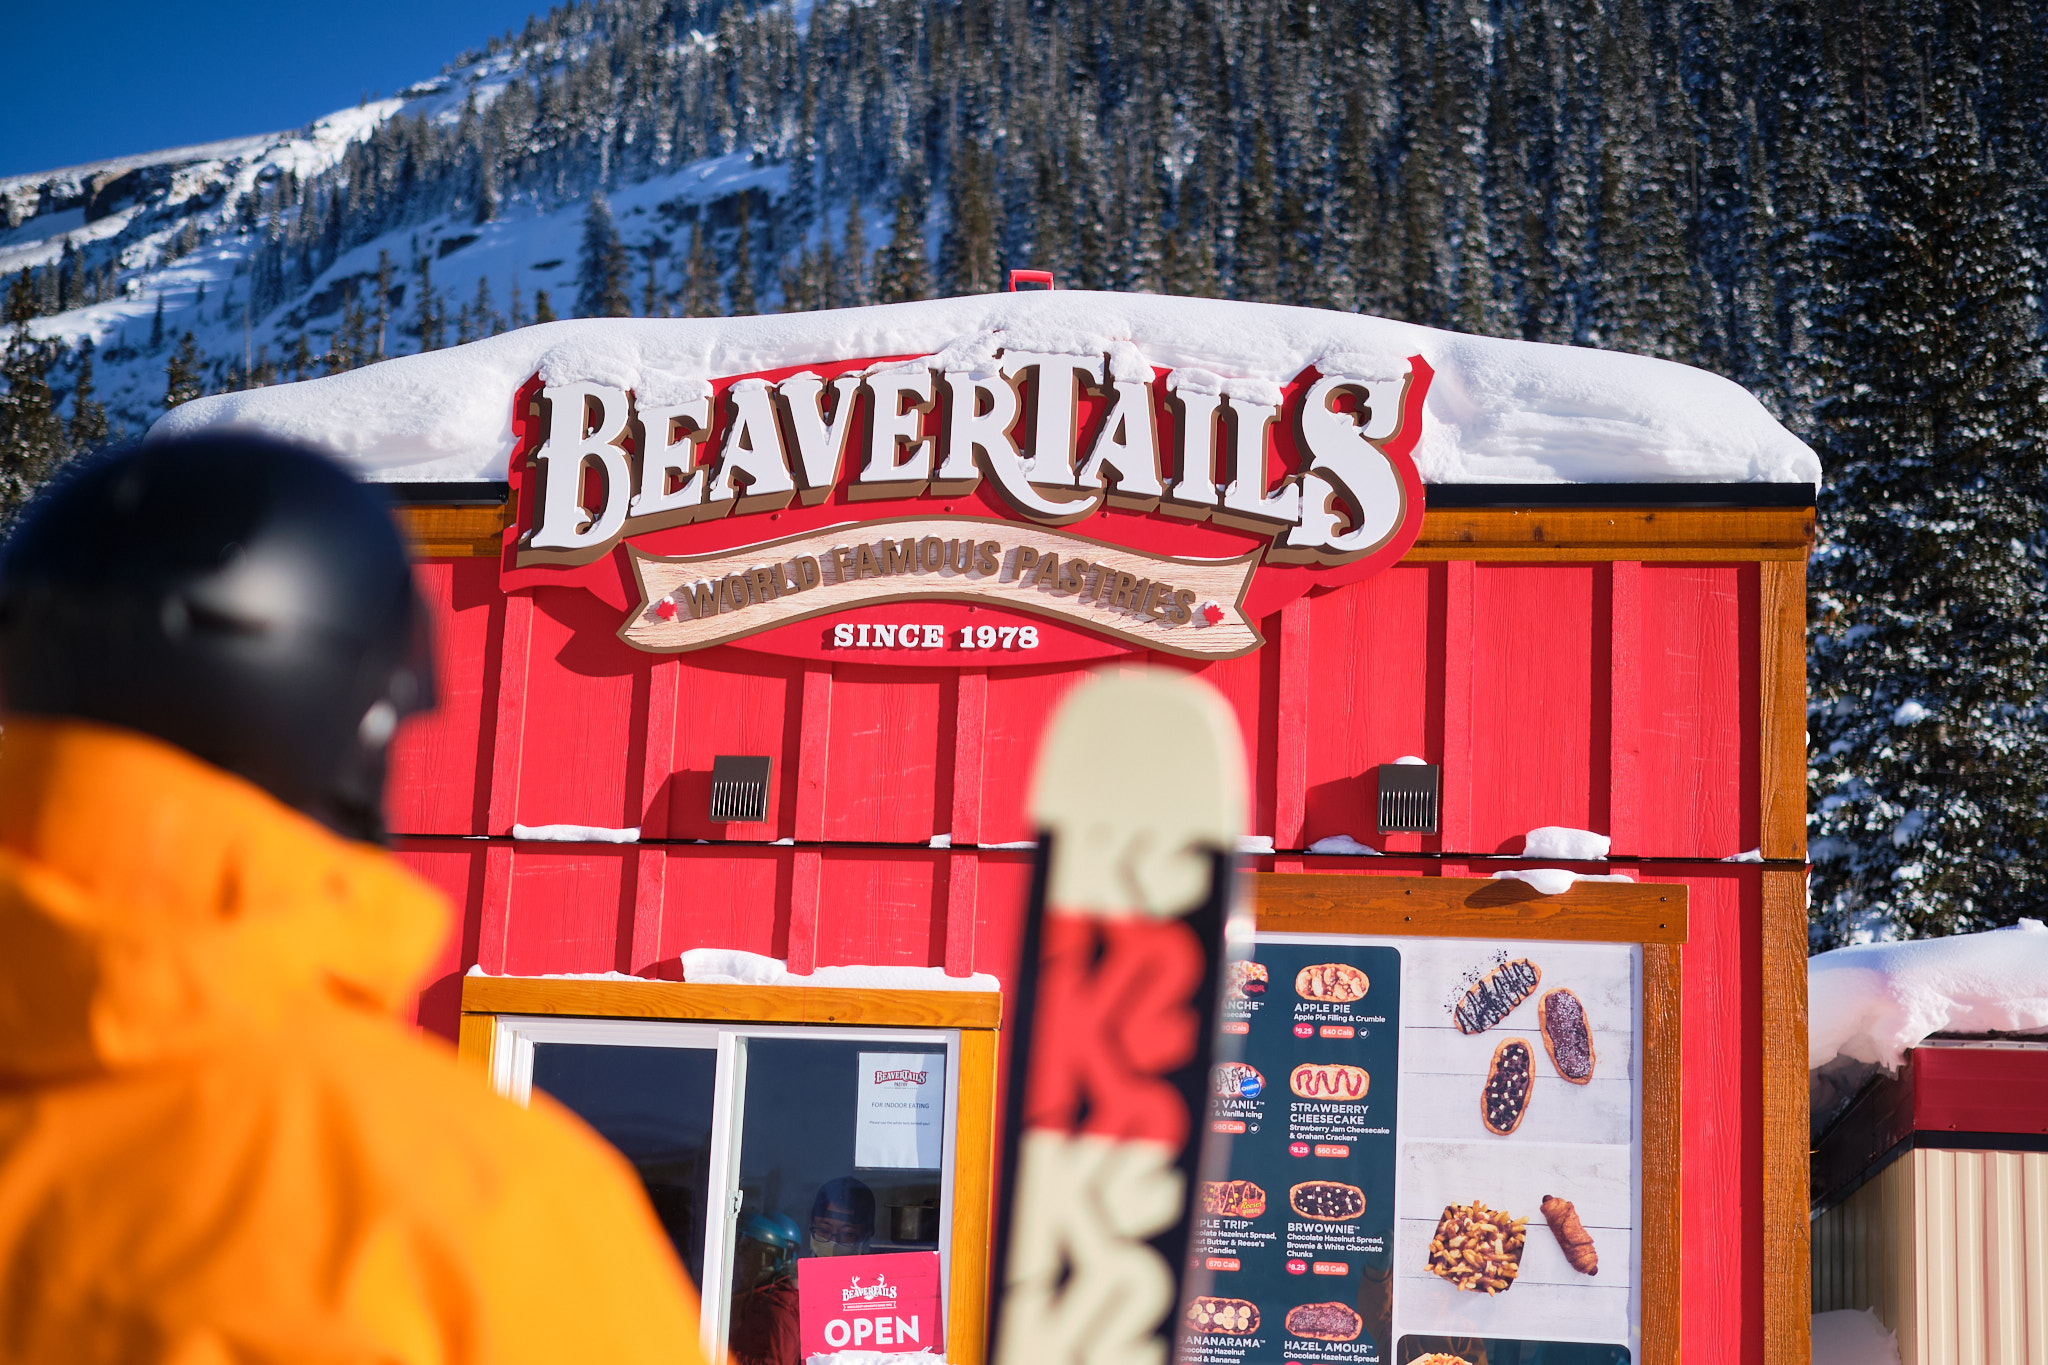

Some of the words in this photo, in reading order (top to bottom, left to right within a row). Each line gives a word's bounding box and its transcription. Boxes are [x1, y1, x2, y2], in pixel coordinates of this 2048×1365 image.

[530, 351, 1406, 551] BEAVERTAILS
[682, 555, 821, 619] WORLD
[832, 536, 1001, 583] FAMOUS
[1011, 545, 1196, 625] PASTRIES
[834, 623, 944, 648] SINCE
[960, 625, 1039, 649] 1978
[1294, 1003, 1330, 1013] APPLE
[1333, 1004, 1350, 1013] PIE
[1290, 1103, 1369, 1114] STRAWBERRY
[1246, 1111, 1262, 1119] Icing
[1290, 1114, 1364, 1125] CHEESECAKE
[1290, 1124, 1329, 1133] Strawberry
[1346, 1126, 1390, 1134] Cheesecake
[1250, 1232, 1276, 1240] Spread,
[824, 1315, 919, 1347] OPEN
[1284, 1341, 1322, 1351] HAZEL
[1354, 1355, 1379, 1363] Spread
